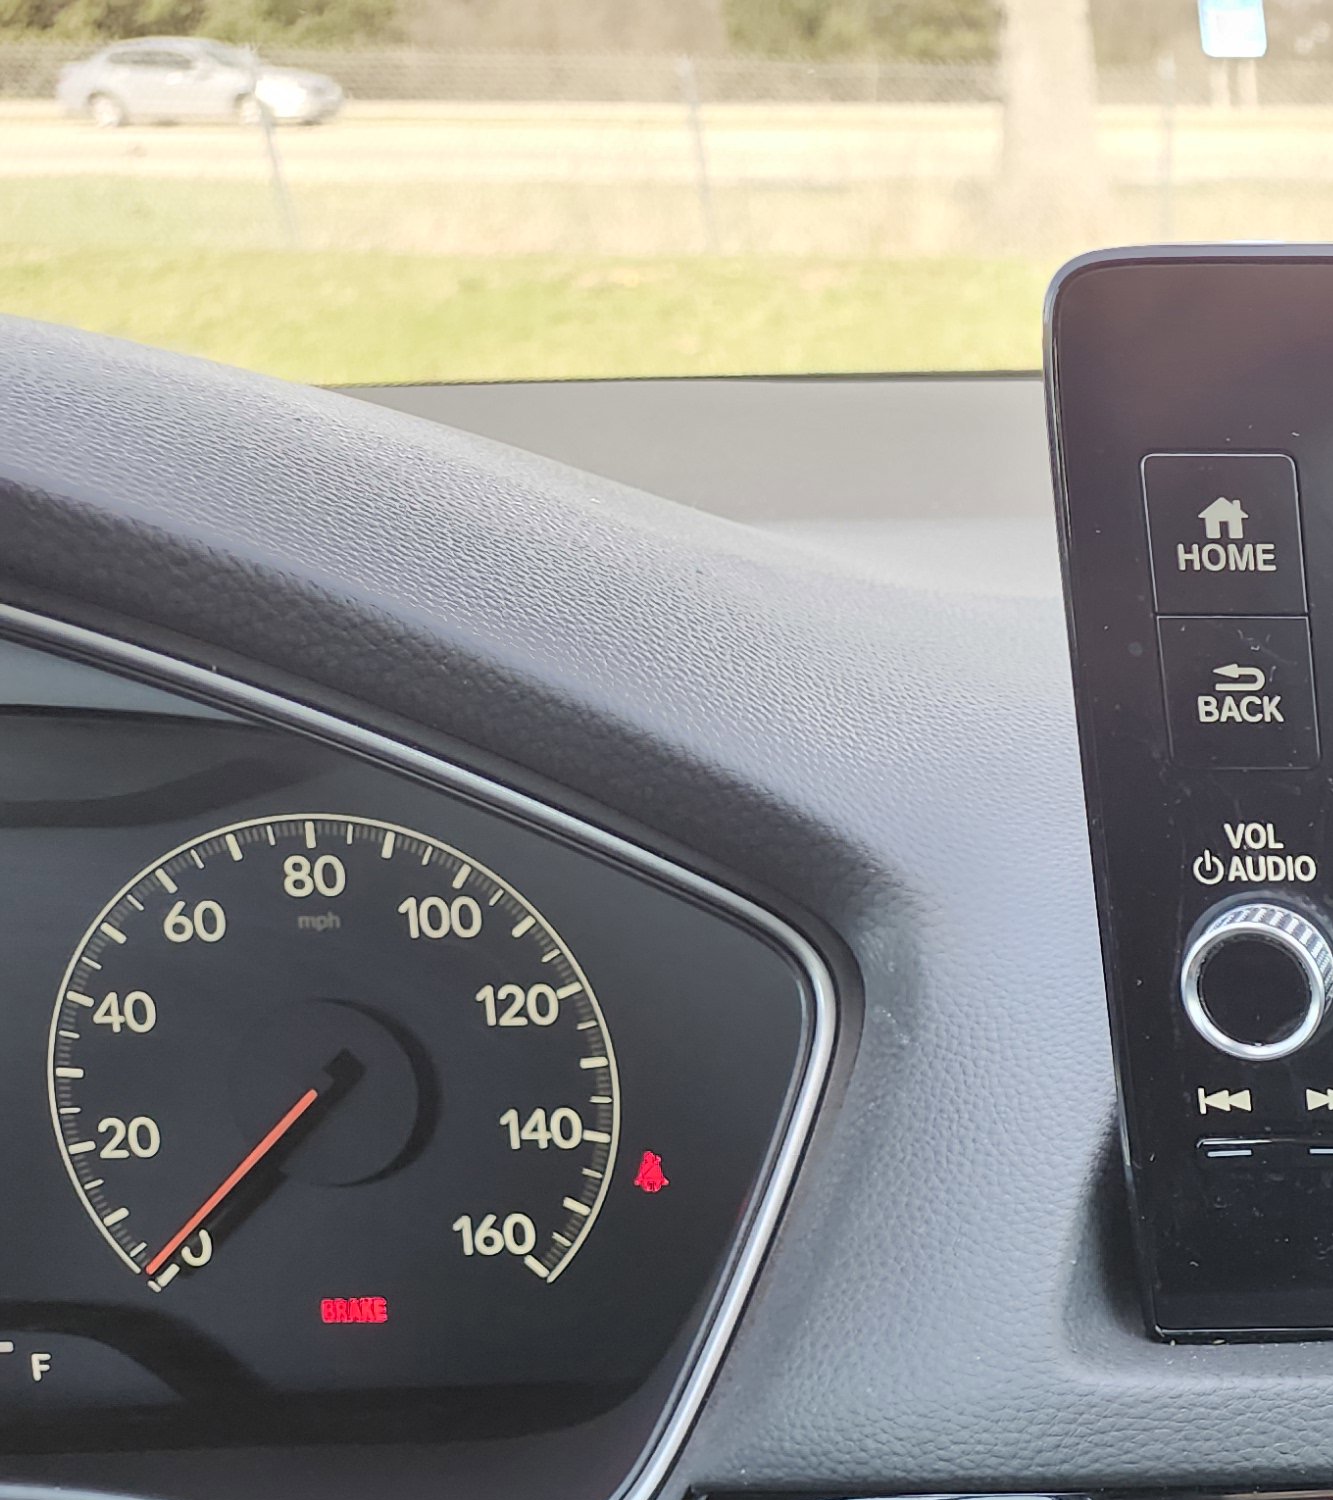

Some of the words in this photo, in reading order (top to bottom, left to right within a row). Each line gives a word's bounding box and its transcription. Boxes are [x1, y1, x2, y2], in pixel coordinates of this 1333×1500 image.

[1177, 543, 1277, 572] HOME
[1197, 695, 1284, 723] BACK
[1223, 822, 1284, 850] VOL
[283, 854, 346, 897] 80
[1227, 855, 1317, 882] AUDIO
[163, 900, 226, 943] 60
[297, 911, 341, 932] mph
[397, 895, 482, 939] 100
[93, 990, 156, 1033] 40
[475, 983, 559, 1026] 120
[97, 1116, 161, 1159] 20
[499, 1107, 583, 1150] 140
[452, 1213, 538, 1258] 160
[320, 1296, 388, 1324] BRAKE
[31, 1353, 51, 1381] F
